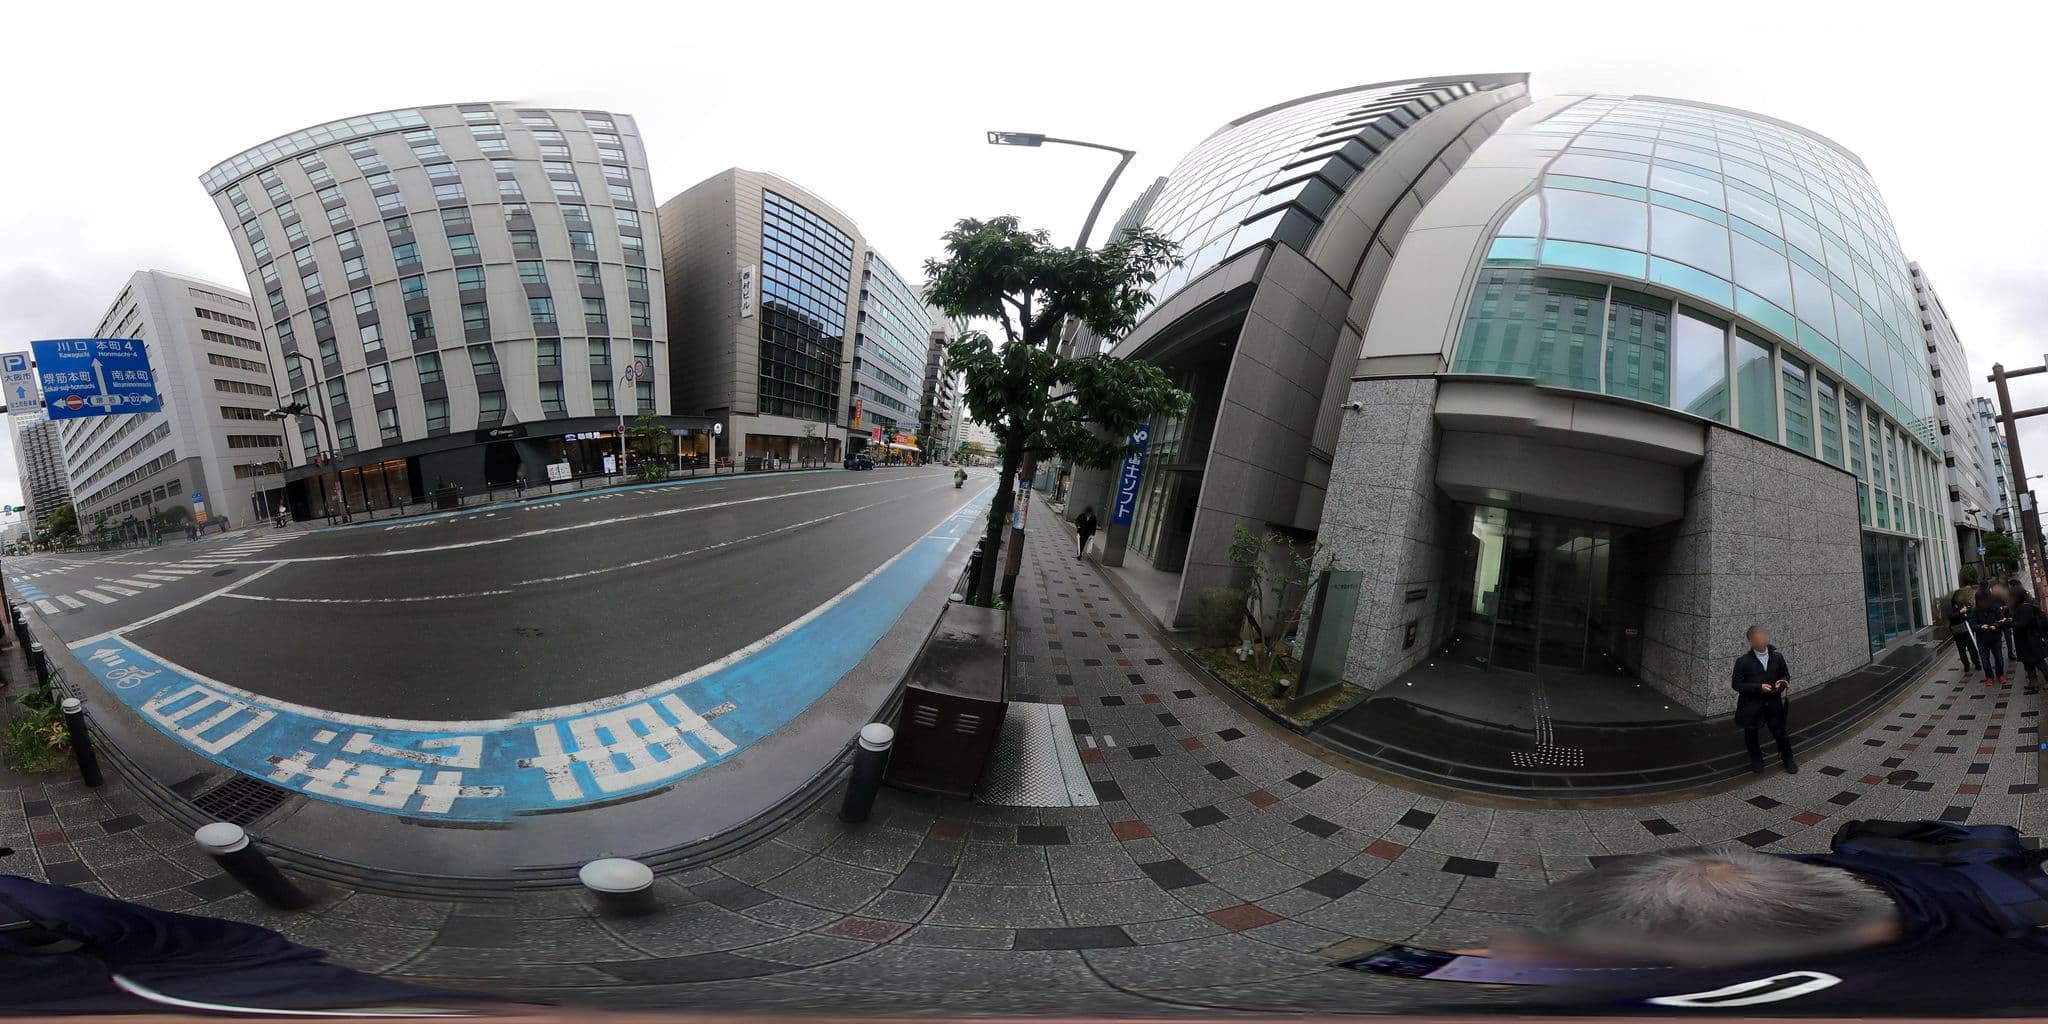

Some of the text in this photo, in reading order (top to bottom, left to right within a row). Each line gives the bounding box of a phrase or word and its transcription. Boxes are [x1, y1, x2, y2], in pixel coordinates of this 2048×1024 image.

[57, 341, 88, 352] 川口
[4, 373, 32, 382] 大阪市
[43, 371, 91, 384] 堺筋本町
[112, 370, 149, 381] 南森町
